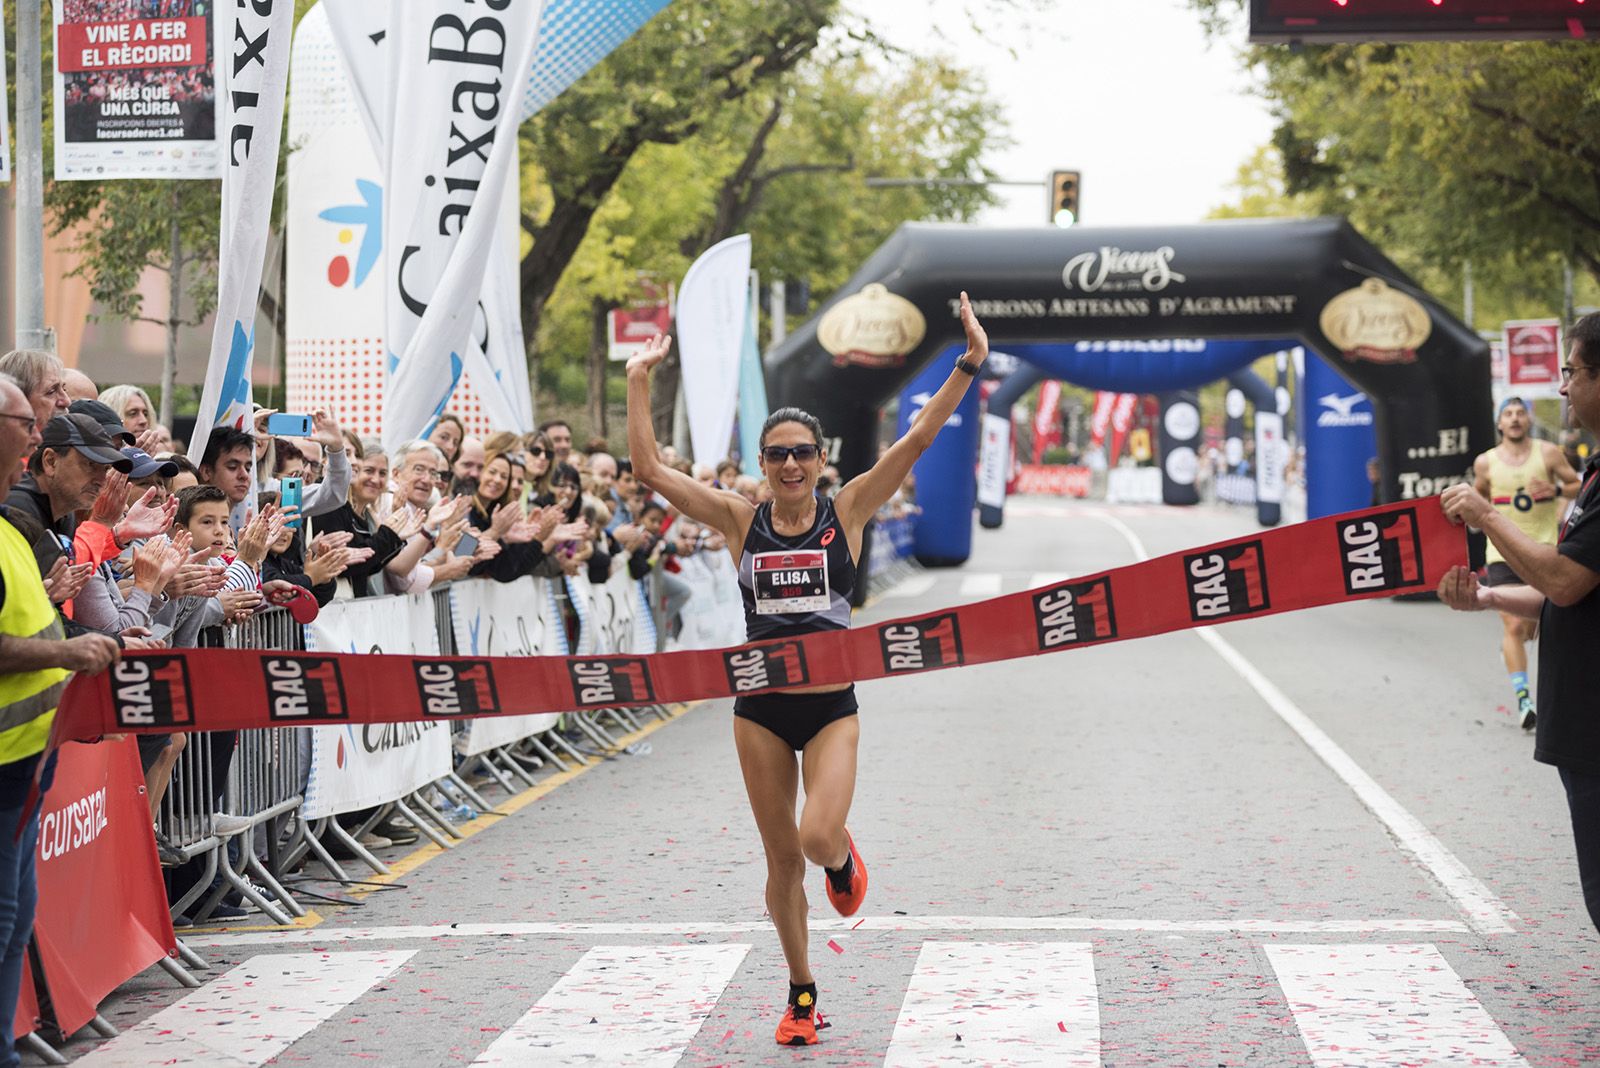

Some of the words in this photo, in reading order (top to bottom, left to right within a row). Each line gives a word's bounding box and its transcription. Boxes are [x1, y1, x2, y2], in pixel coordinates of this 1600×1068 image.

[85, 24, 130, 43] VINE
[133, 22, 147, 41] A
[150, 21, 187, 40] FER
[81, 48, 104, 67] EL
[101, 102, 130, 116] UNA
[132, 101, 180, 116] CURSA
[141, 86, 170, 101] QUE
[398, 0, 512, 318] CaixaB
[1050, 298, 1149, 318] ARTESANS
[1343, 521, 1386, 590] RAC
[772, 570, 811, 586] ELISA
[1190, 554, 1231, 617] RAC
[1039, 589, 1077, 647] RAC
[884, 626, 924, 669] RAC
[268, 660, 309, 716] RAC
[419, 664, 461, 714] RAC
[574, 662, 615, 704] RAC
[730, 649, 769, 692] RAC
[115, 661, 155, 724] RAC
